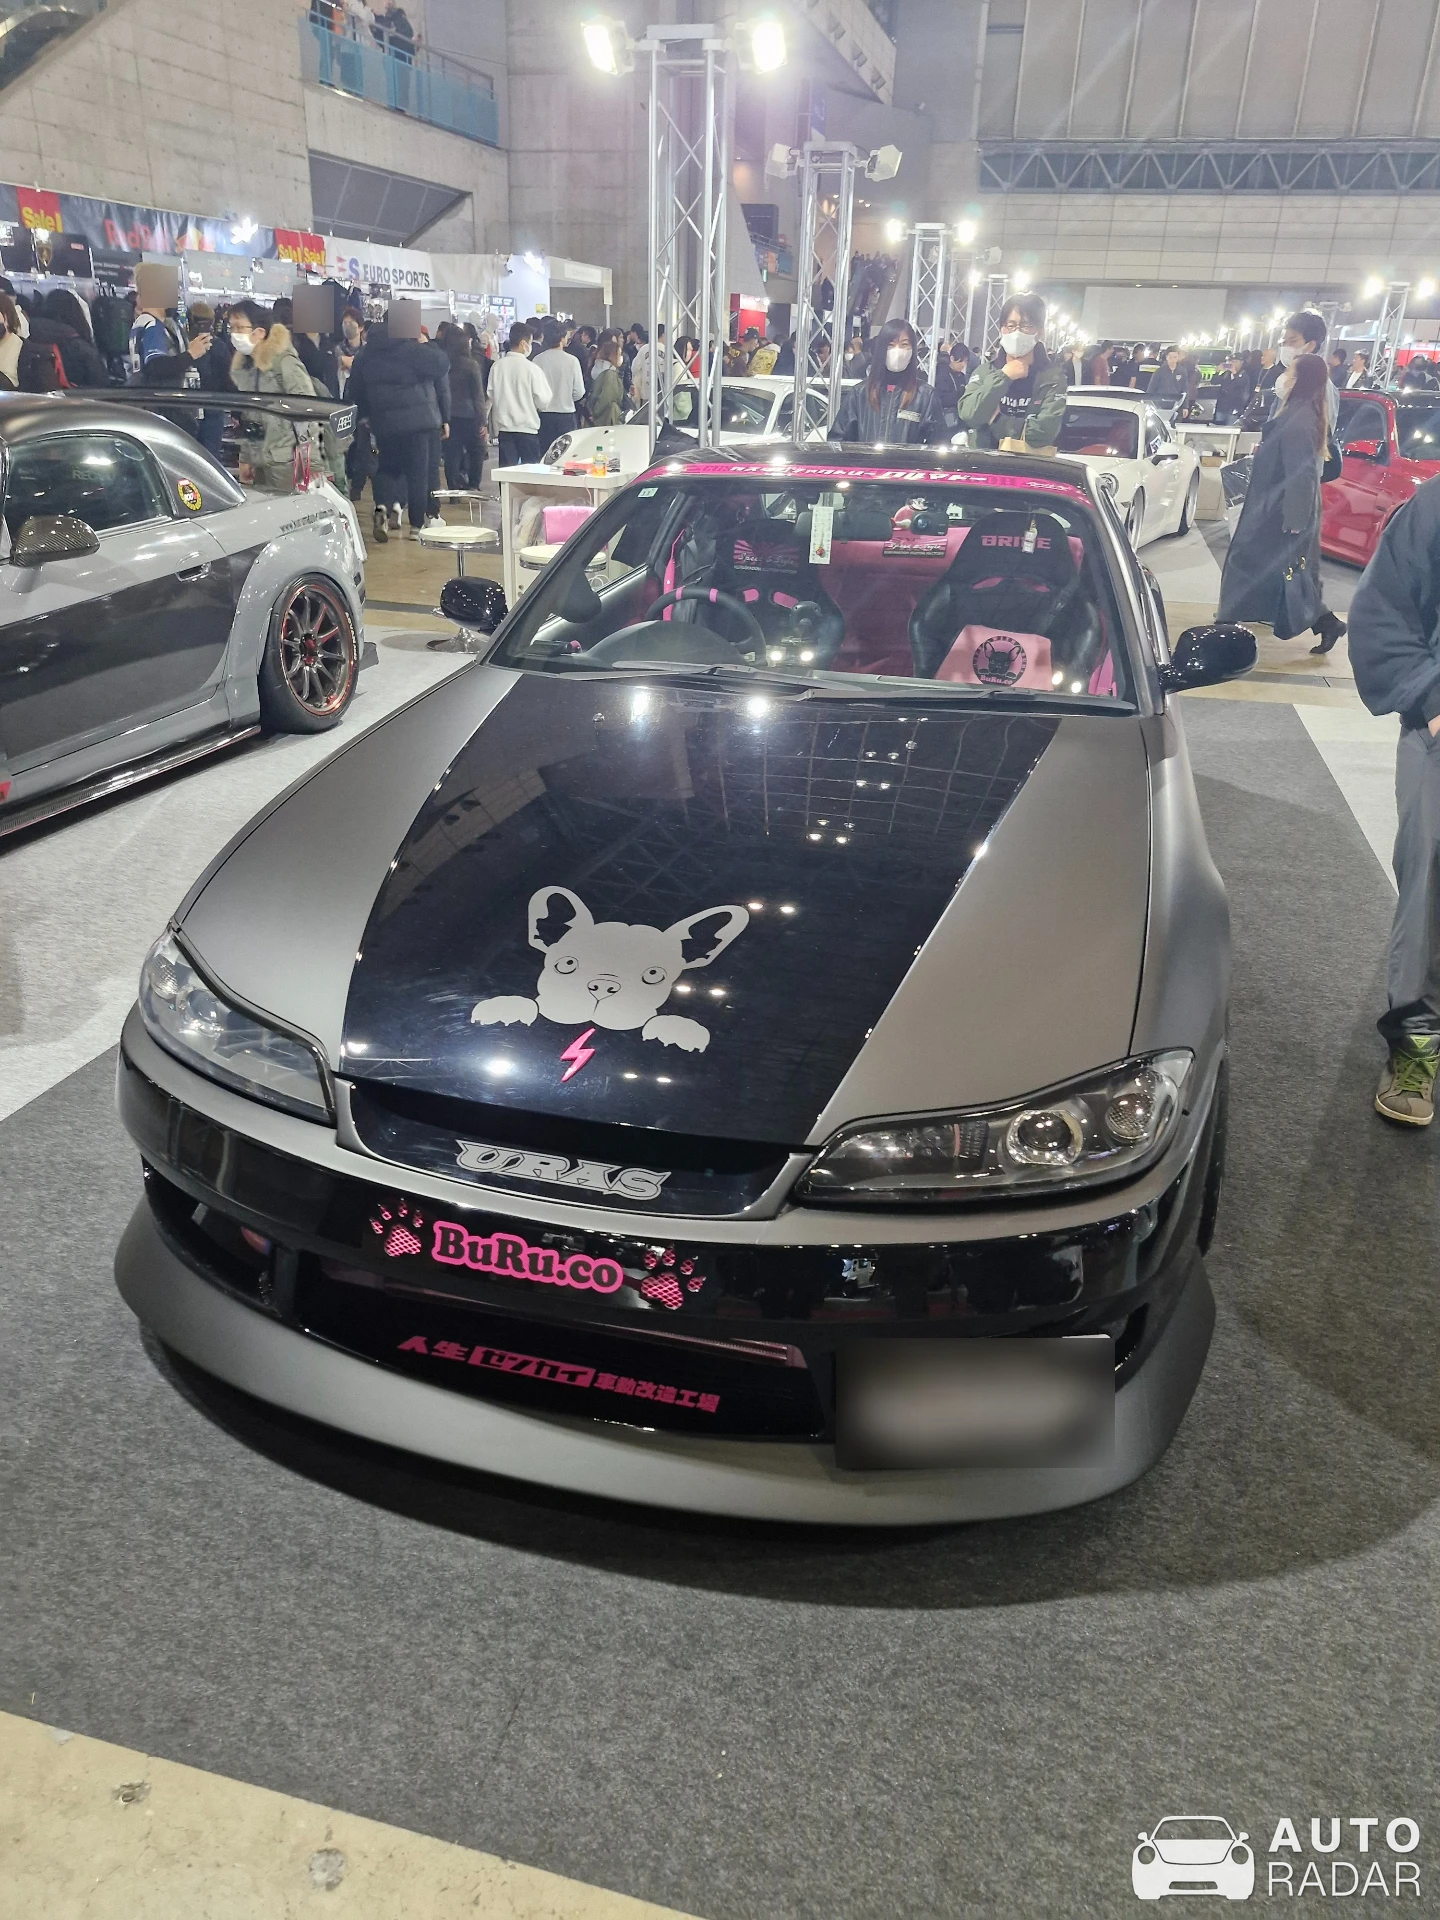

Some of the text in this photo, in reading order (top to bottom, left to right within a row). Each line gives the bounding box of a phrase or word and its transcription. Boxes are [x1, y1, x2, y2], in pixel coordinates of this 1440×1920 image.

[22, 206, 63, 233] Sale!
[363, 264, 391, 284] EURO
[391, 269, 430, 288] SPORTS
[981, 535, 1052, 550] BRIE
[455, 1139, 672, 1200] URAS
[432, 1220, 624, 1294] BuRu.co
